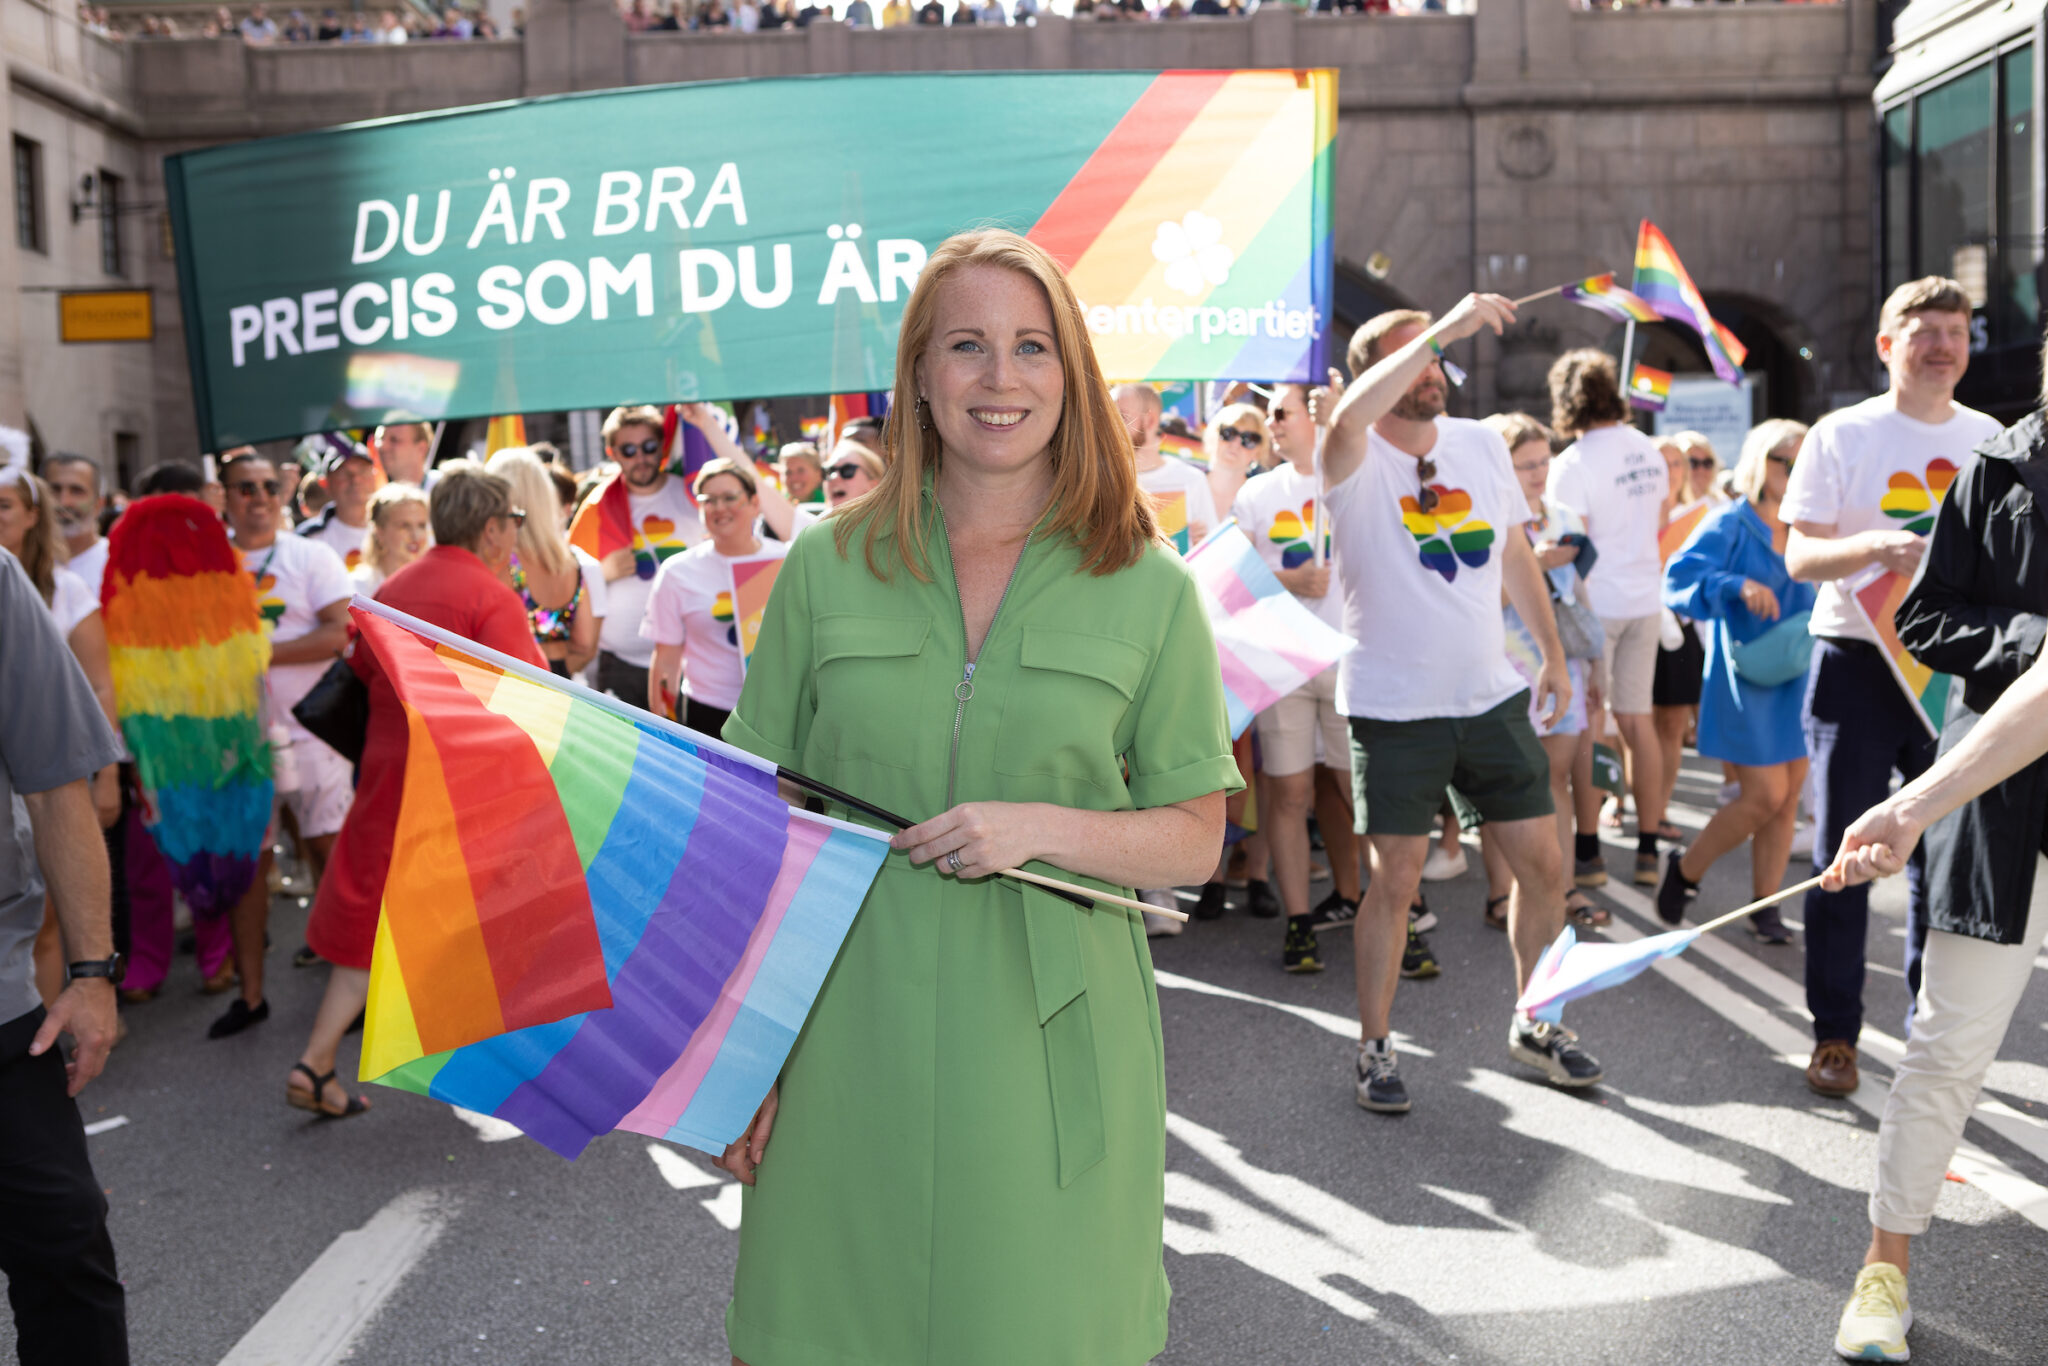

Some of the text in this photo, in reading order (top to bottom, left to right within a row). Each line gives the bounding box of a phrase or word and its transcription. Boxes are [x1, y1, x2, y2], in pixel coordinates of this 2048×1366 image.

[352, 162, 748, 264] DU ÄR BRA
[230, 223, 928, 366] PRECIS SOM DU ÄR
